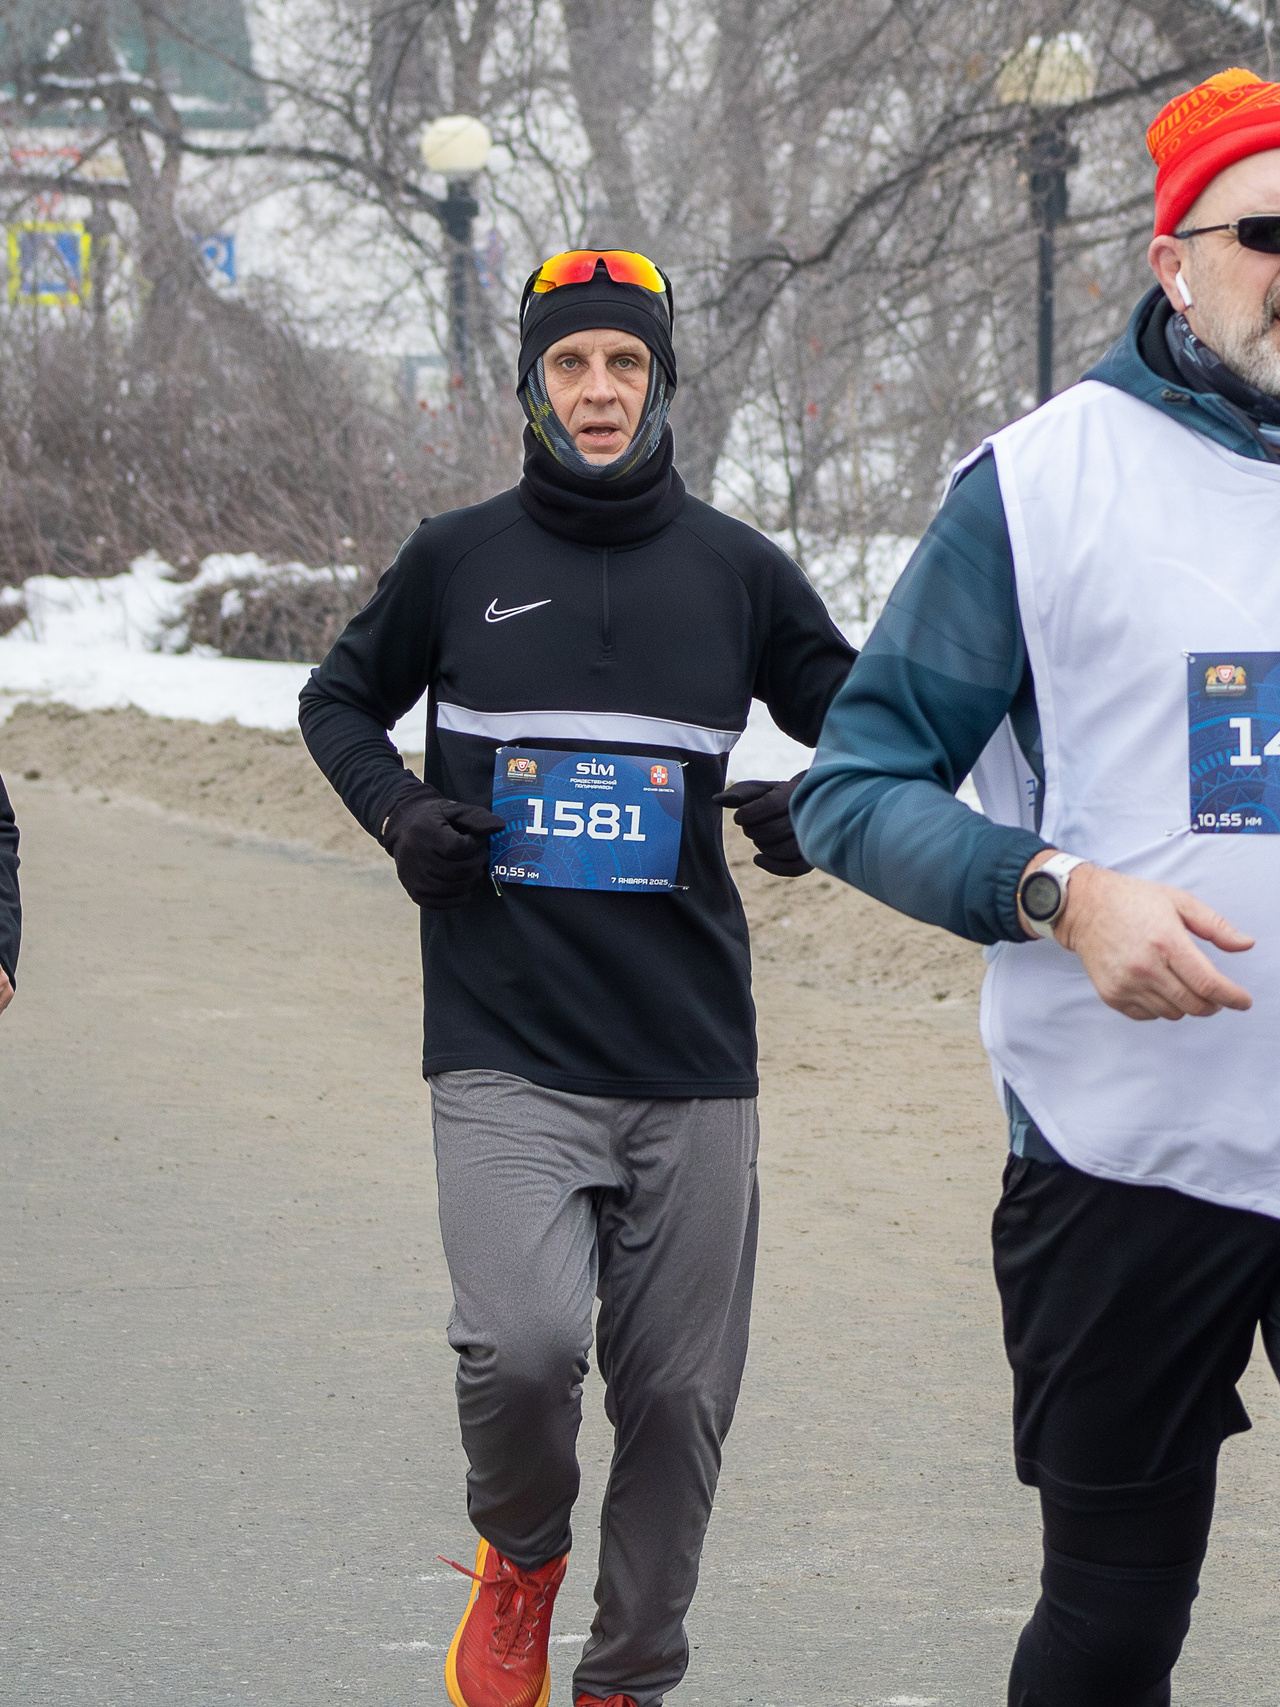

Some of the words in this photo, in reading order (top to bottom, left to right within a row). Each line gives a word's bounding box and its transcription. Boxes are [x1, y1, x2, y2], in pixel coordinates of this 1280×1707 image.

[525, 798, 646, 842] 1581
[1197, 813, 1242, 828] 10,55
[494, 865, 526, 878] 10,55
[618, 877, 648, 885] ЯНВАРЯ
